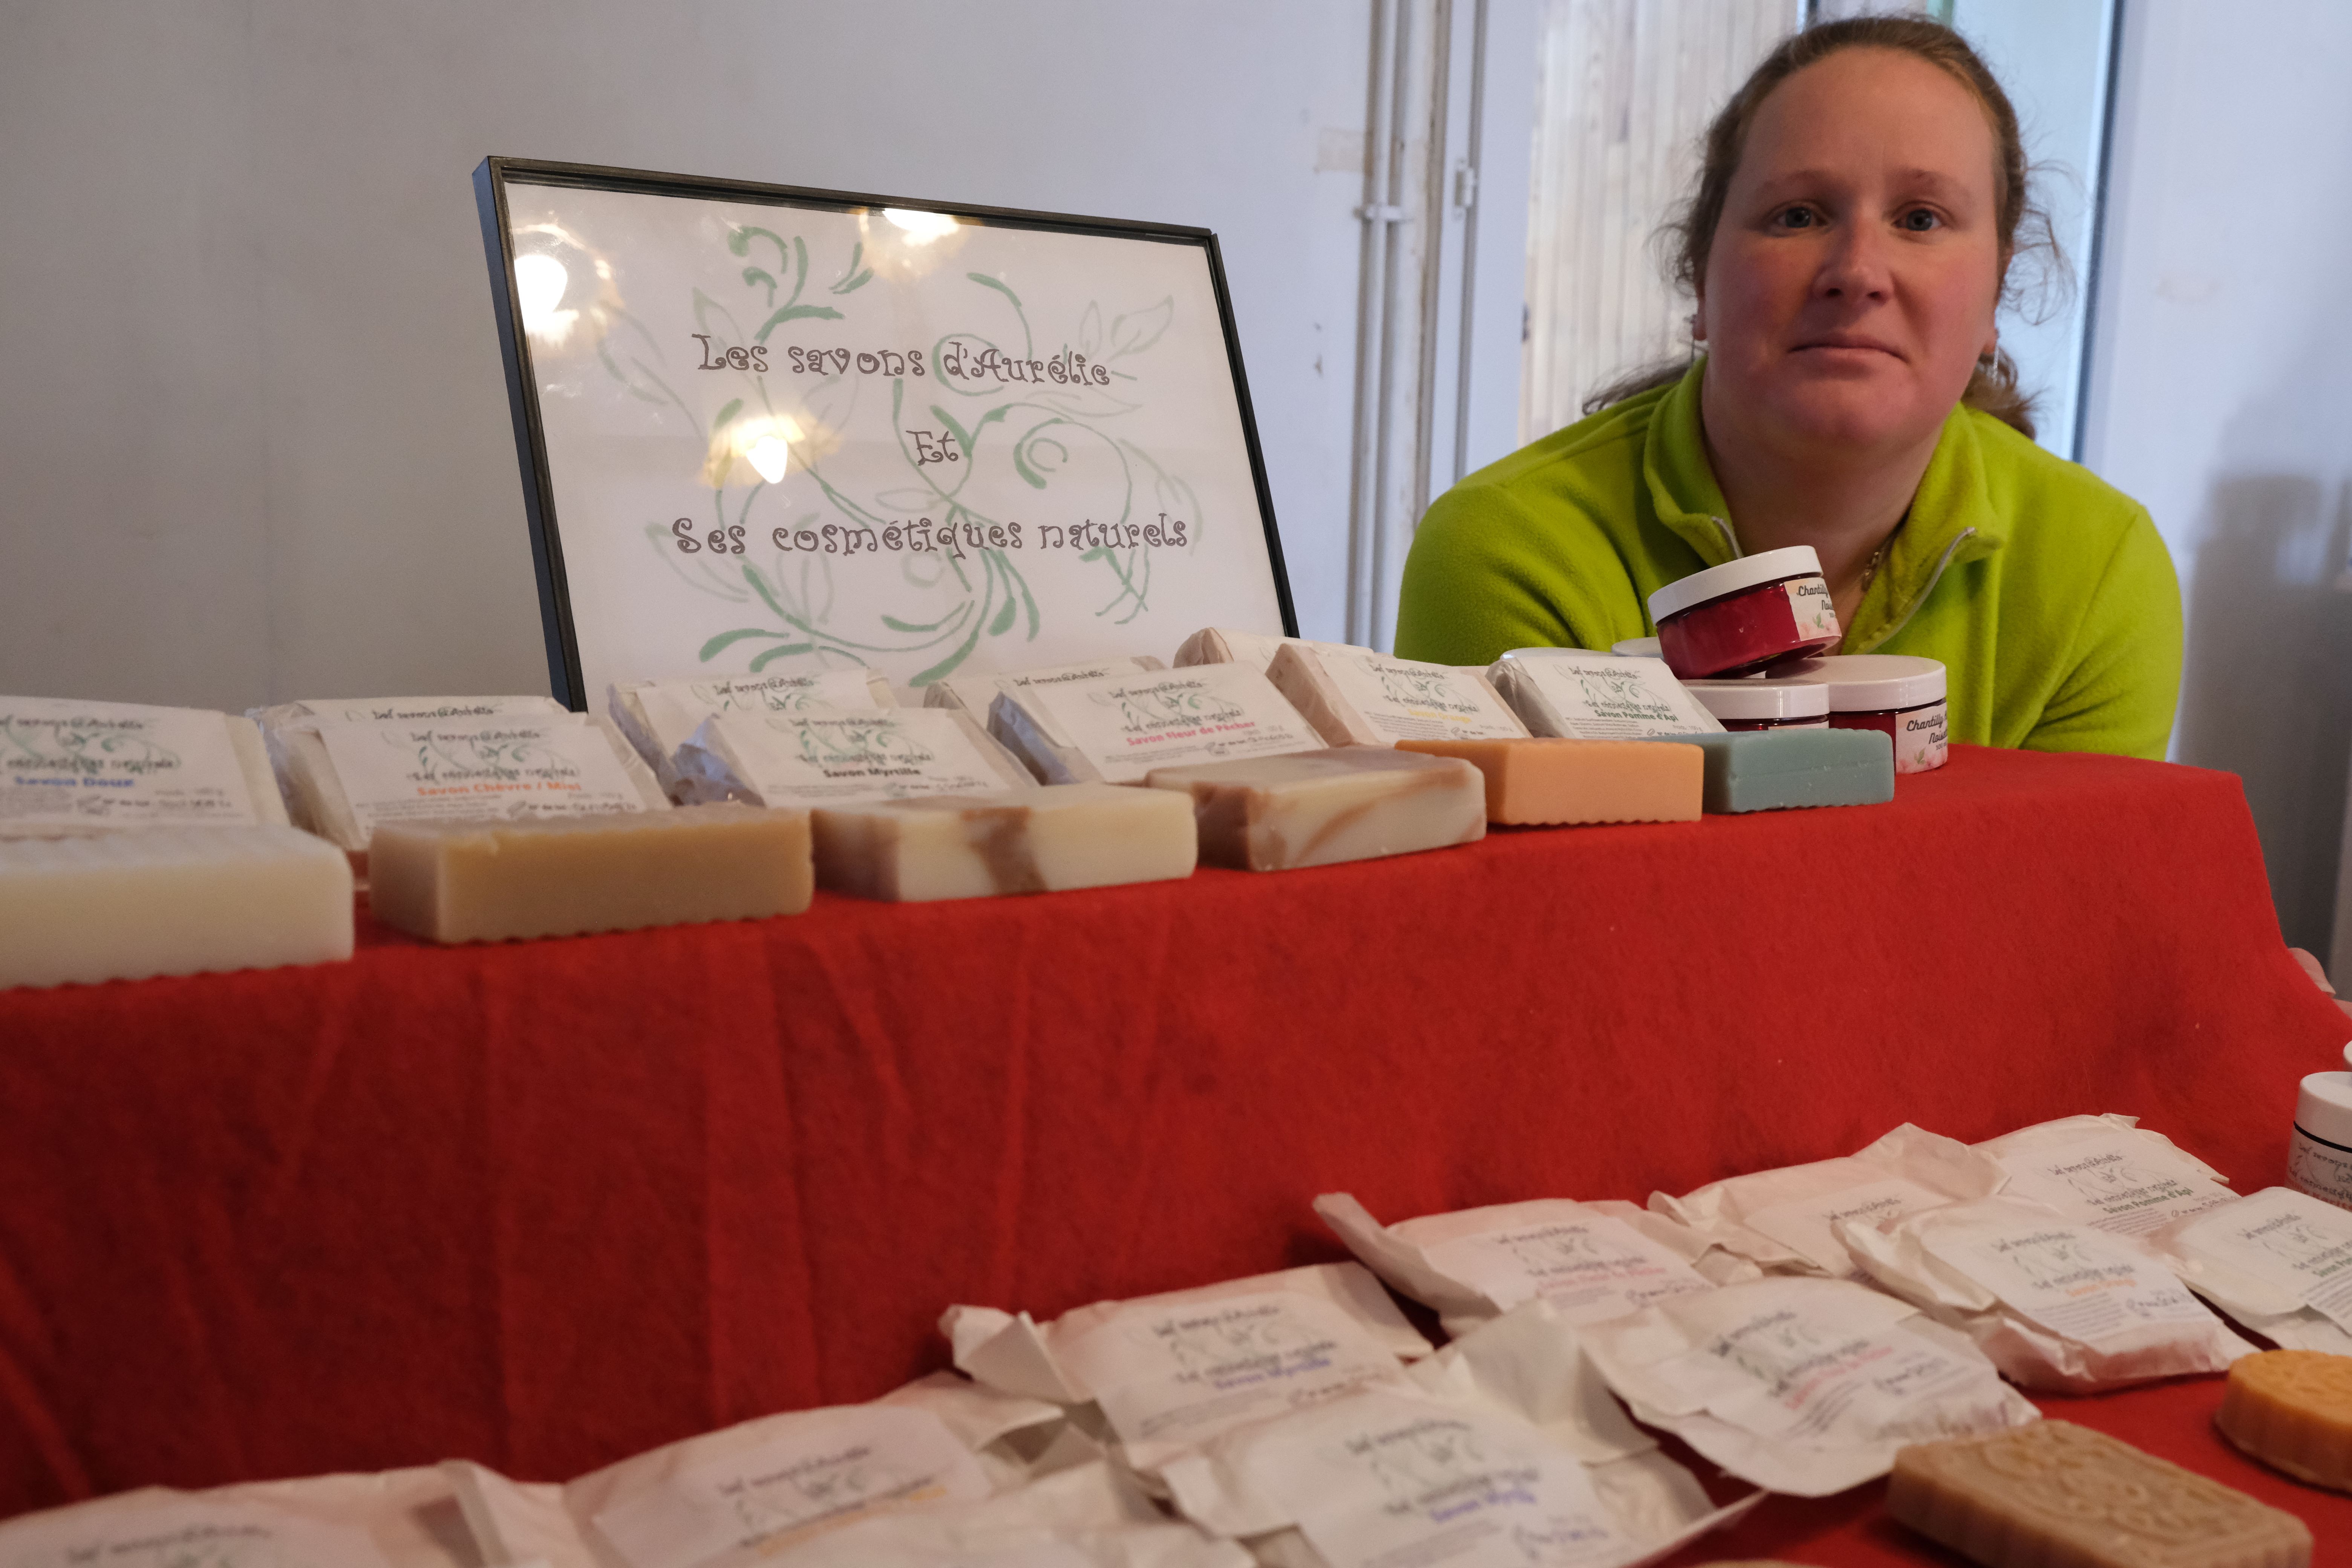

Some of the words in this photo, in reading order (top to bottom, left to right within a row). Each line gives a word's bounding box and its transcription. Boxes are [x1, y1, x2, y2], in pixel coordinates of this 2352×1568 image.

[692, 334, 769, 373] Les
[789, 342, 925, 377] savons
[942, 341, 1110, 386] d'Aurélie
[906, 430, 959, 466] Et
[673, 518, 746, 554] Ses
[772, 518, 1023, 559] cosmétiques
[1040, 513, 1188, 551] naturels
[1906, 714, 1943, 731] Chantilly
